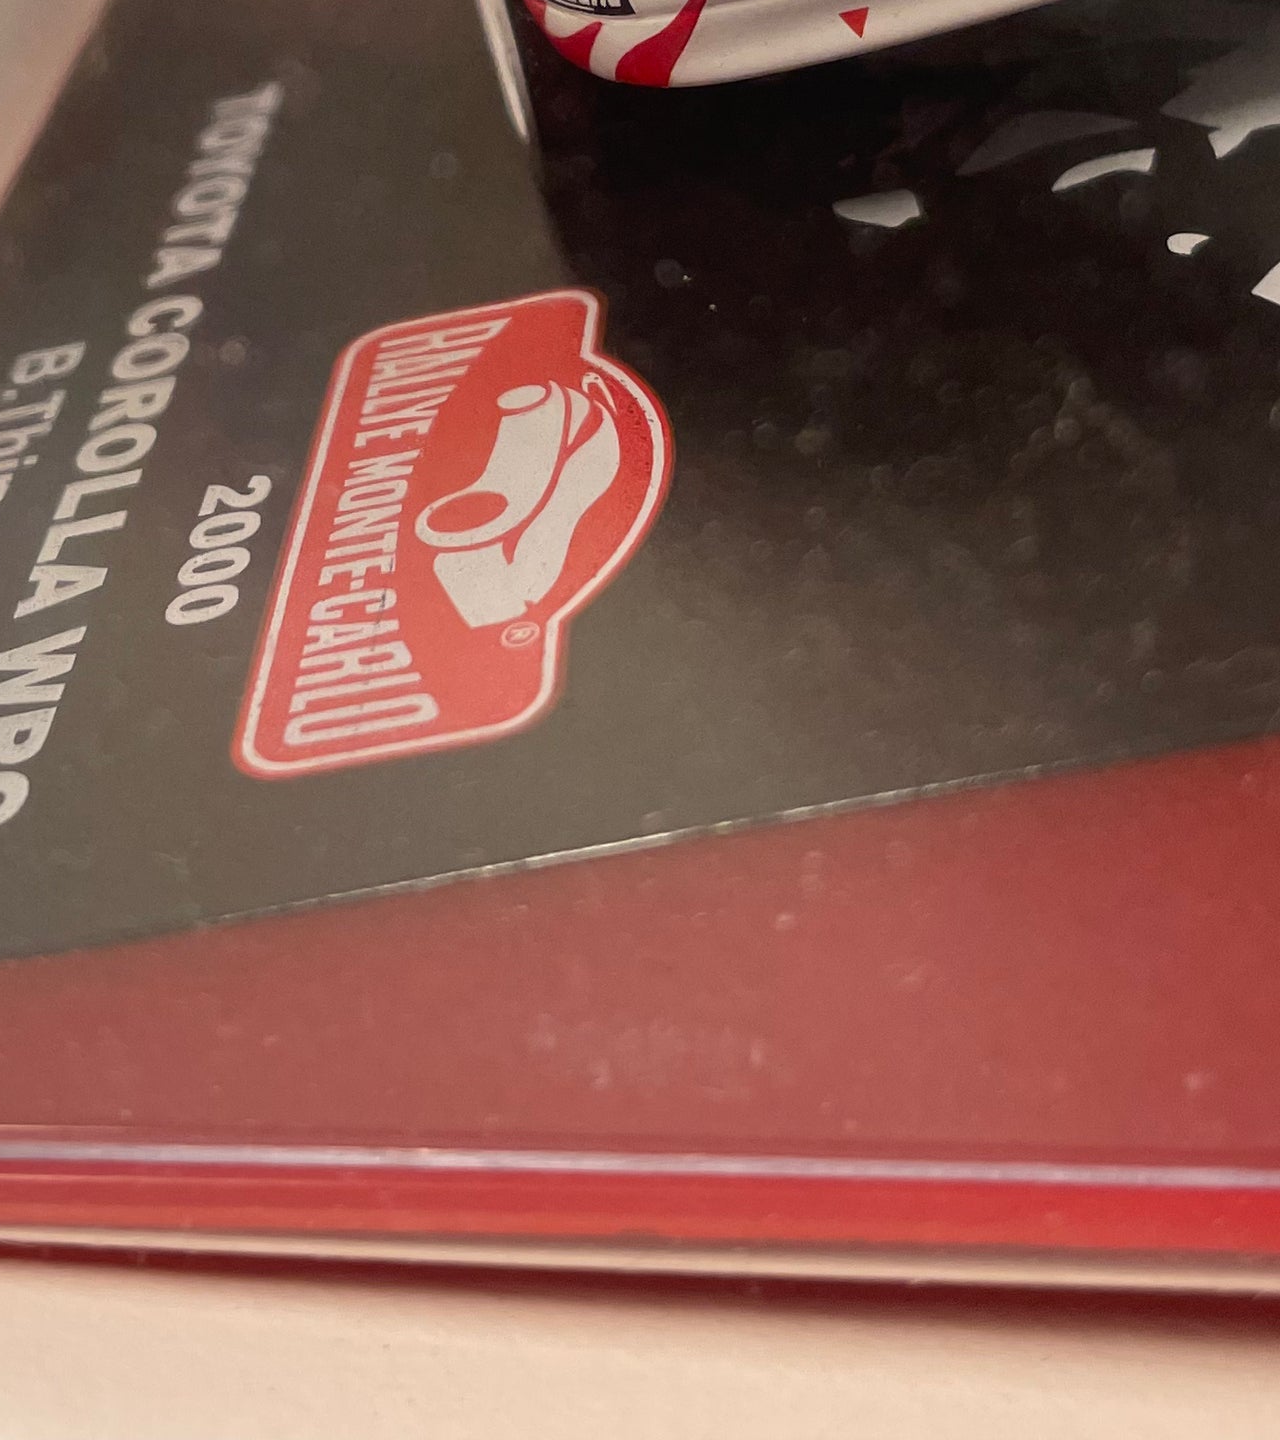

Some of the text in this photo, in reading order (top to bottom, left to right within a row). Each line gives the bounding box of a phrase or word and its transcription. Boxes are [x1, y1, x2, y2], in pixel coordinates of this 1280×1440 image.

[144, 80, 284, 290] TOYOTA
[13, 294, 204, 619] COROLLA
[164, 474, 273, 626] 2000
[283, 316, 513, 747] RALLYE MONTE-CARLO
